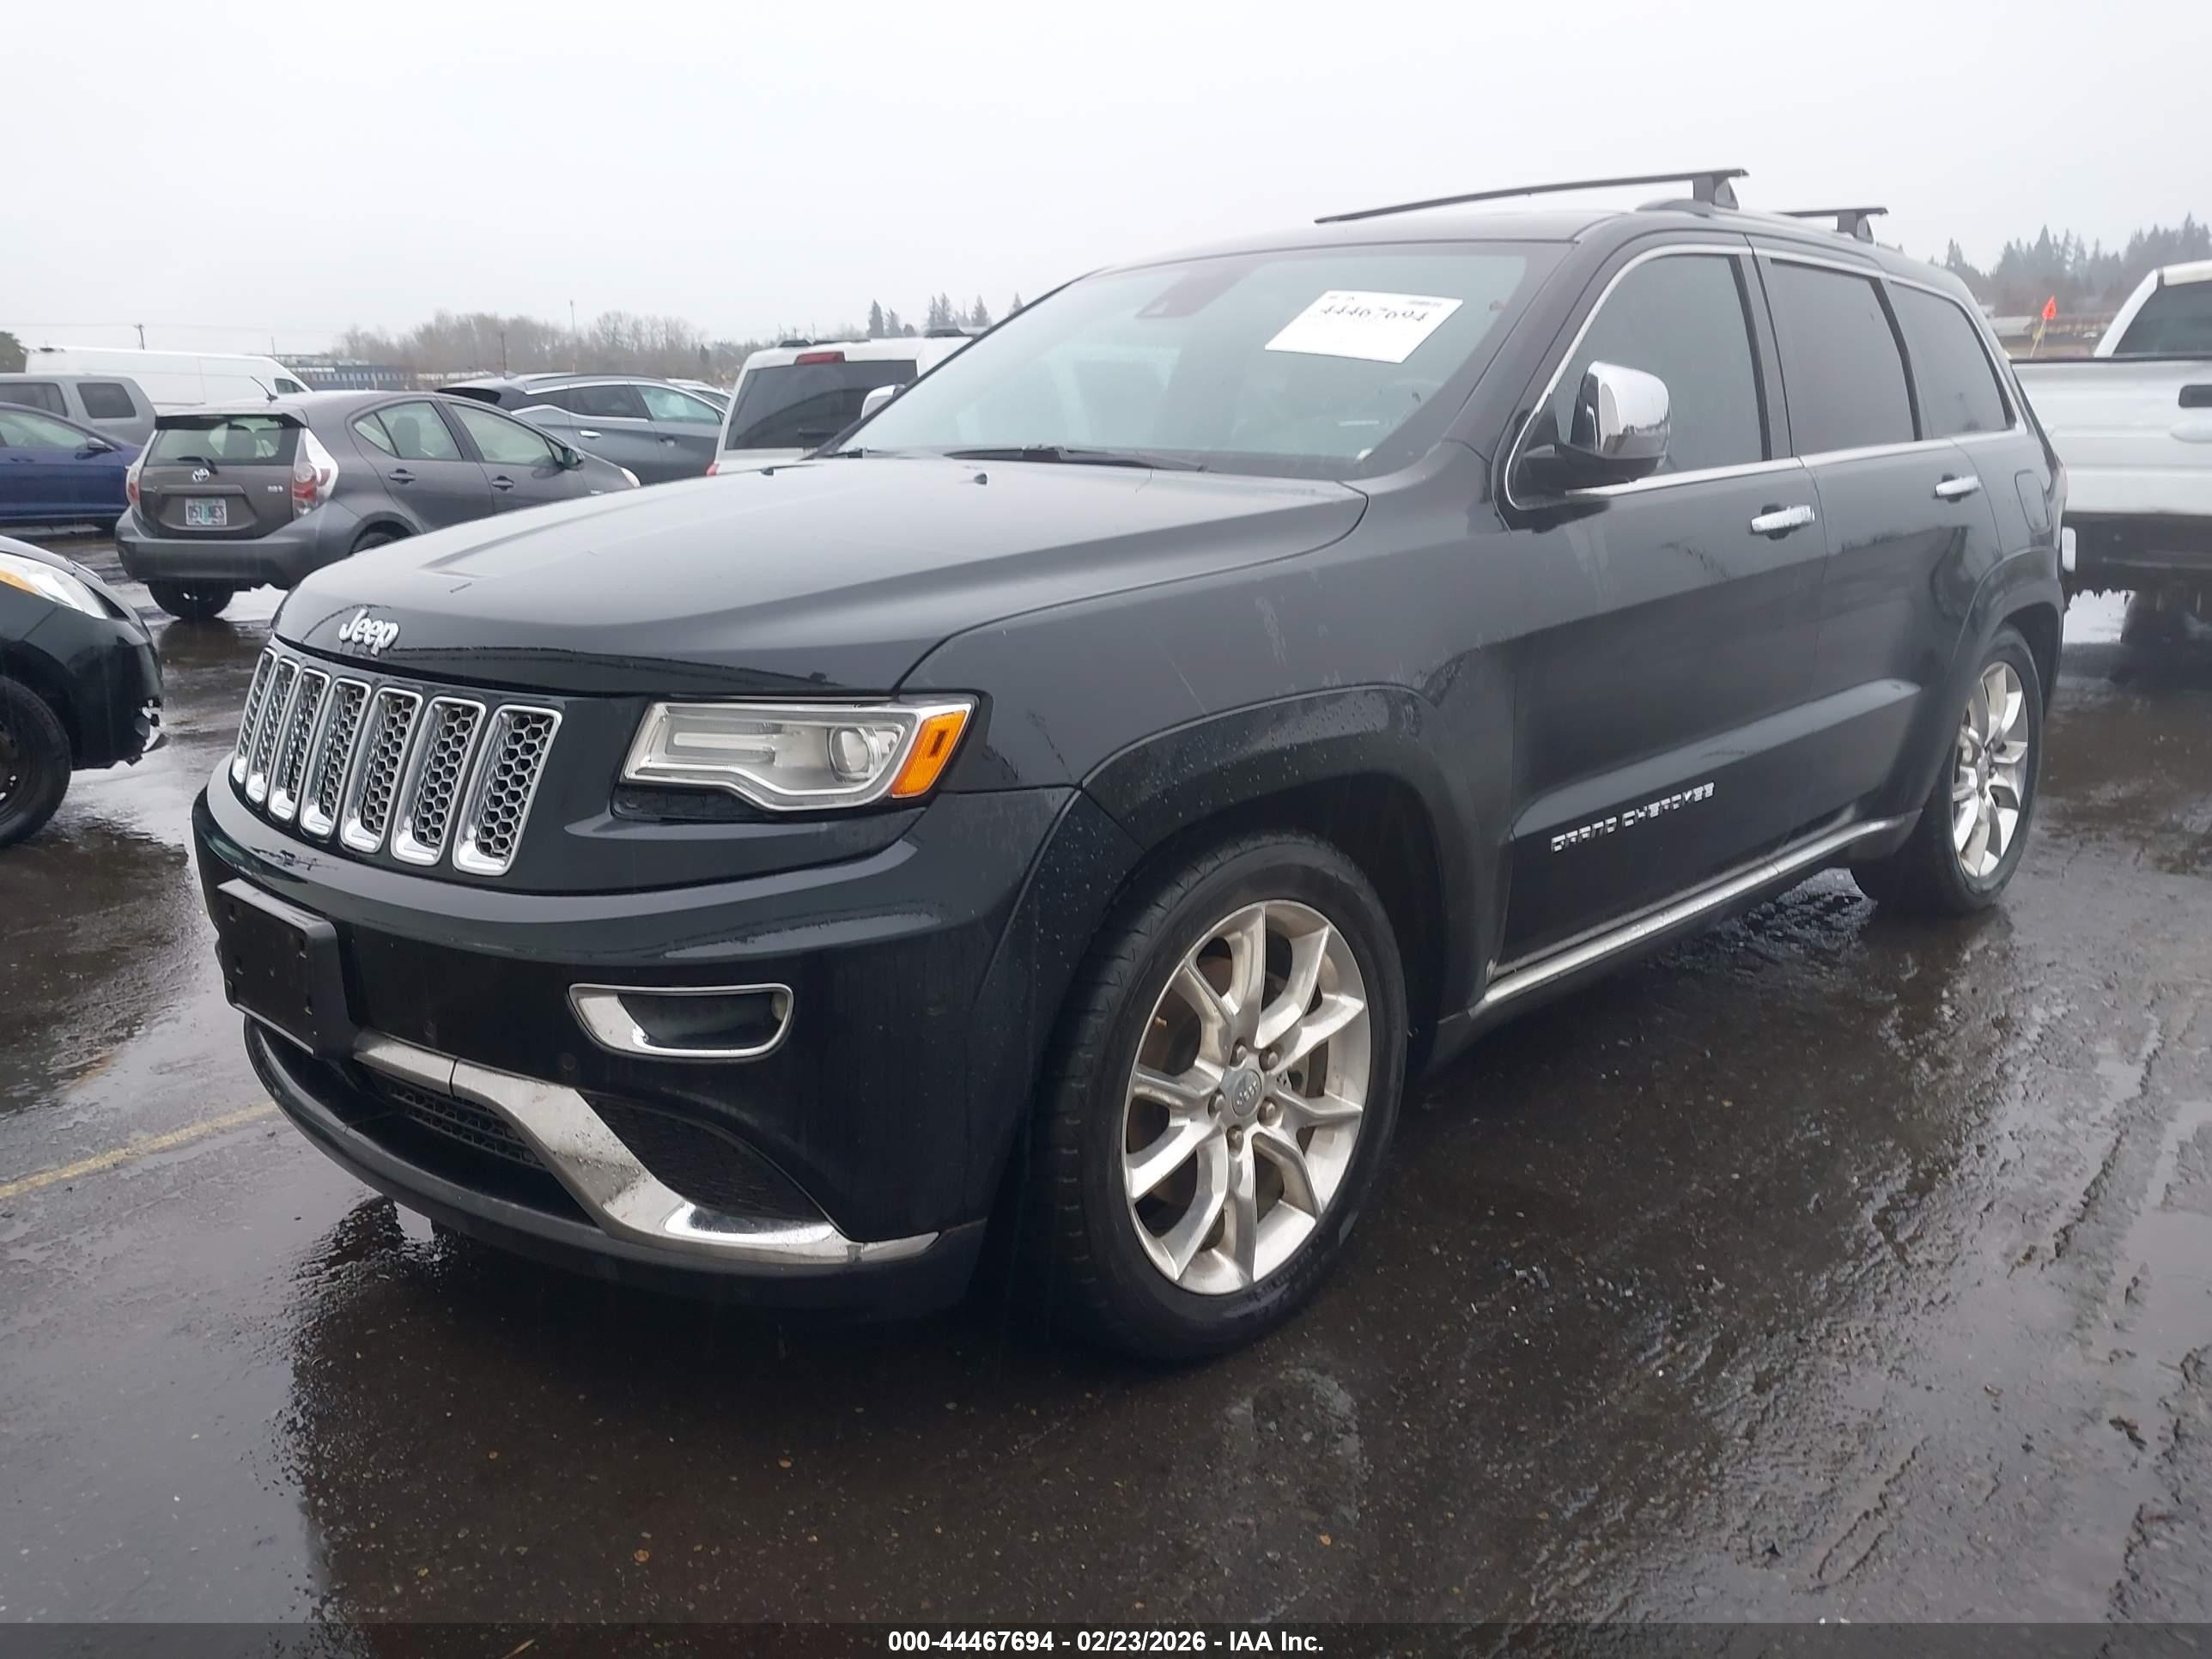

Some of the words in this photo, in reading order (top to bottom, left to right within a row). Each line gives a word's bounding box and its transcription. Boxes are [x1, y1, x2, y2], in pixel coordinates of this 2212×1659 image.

[338, 608, 399, 656] Jeep
[1551, 817, 1617, 852] GRAND
[1622, 782, 1715, 827] CHEROKEE
